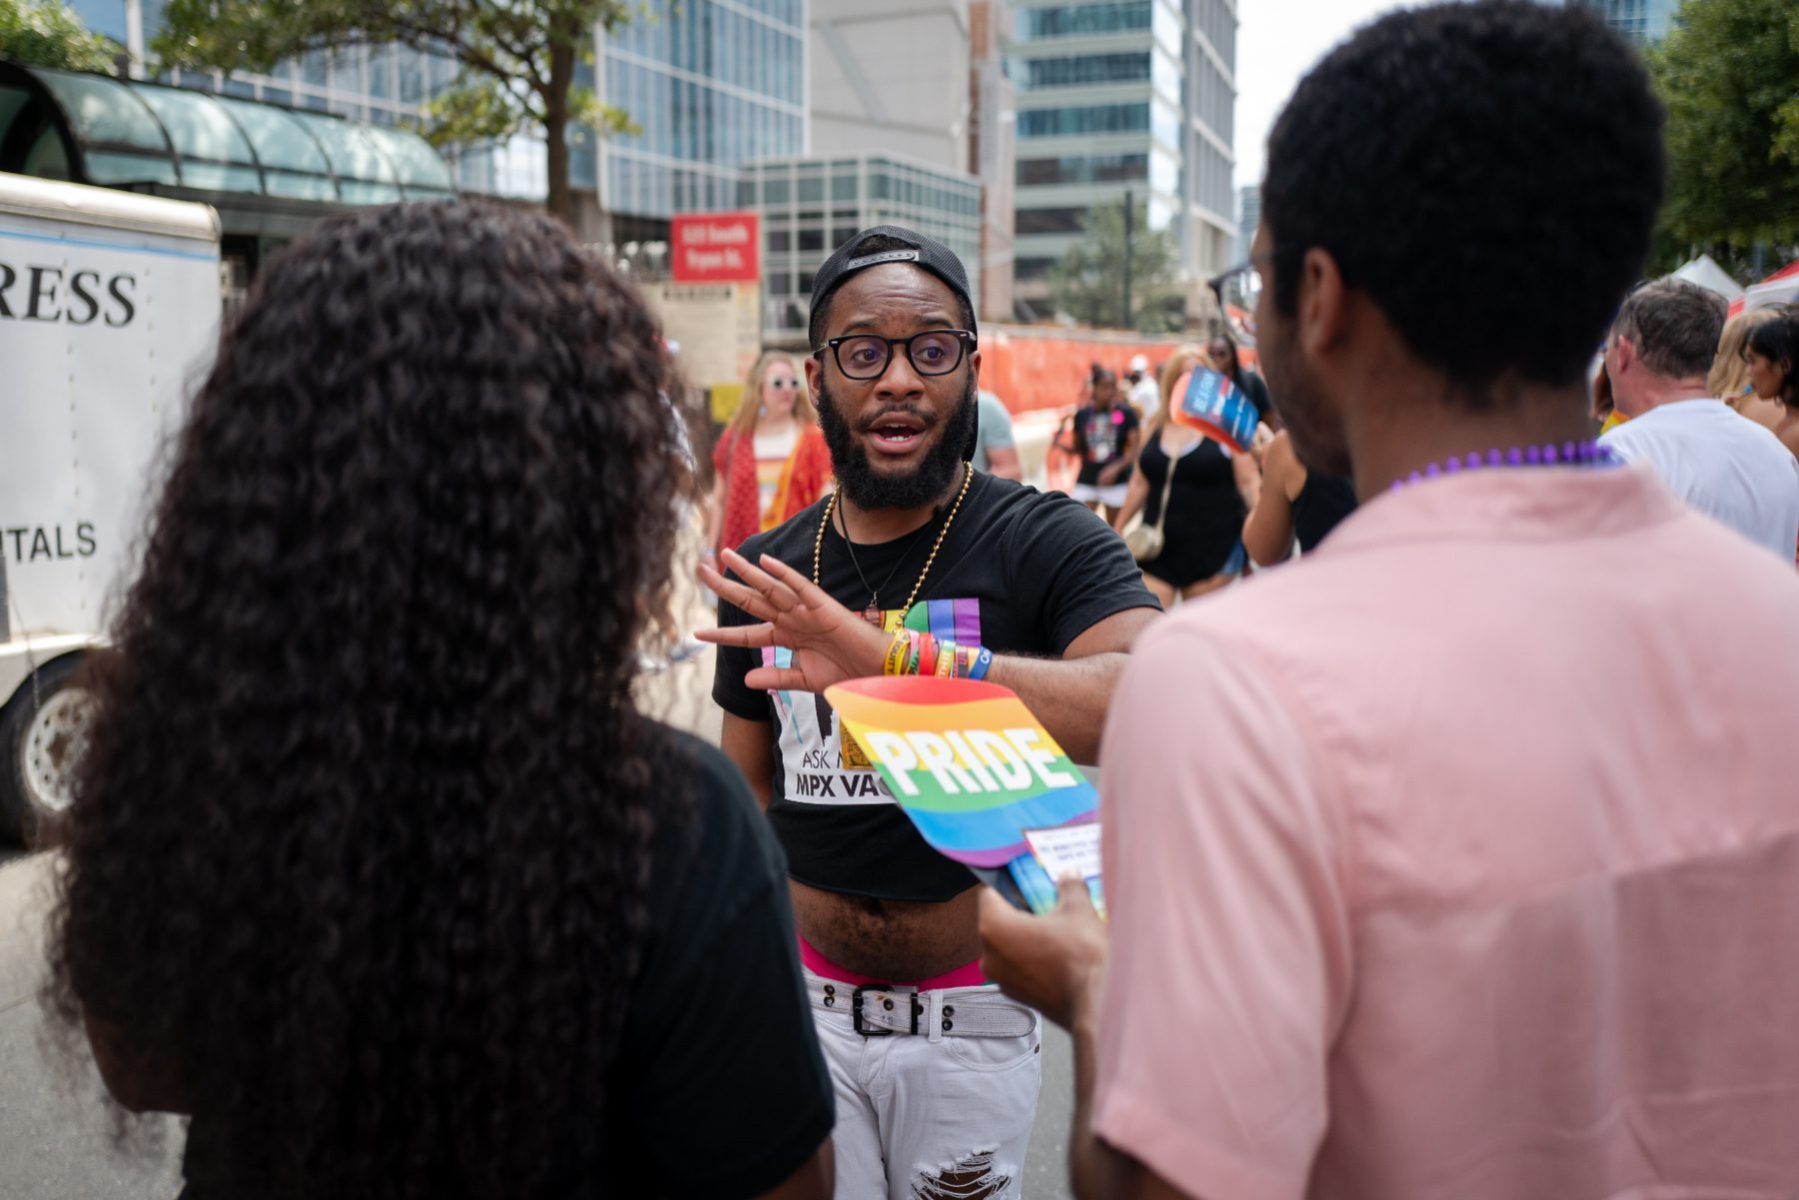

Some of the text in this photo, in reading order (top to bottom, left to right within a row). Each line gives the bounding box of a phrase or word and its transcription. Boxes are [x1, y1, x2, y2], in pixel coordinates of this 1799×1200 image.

[0, 522, 97, 562] TALS
[803, 749, 831, 769] ASK
[864, 728, 1078, 796] PRIDE
[796, 773, 836, 797] MPX
